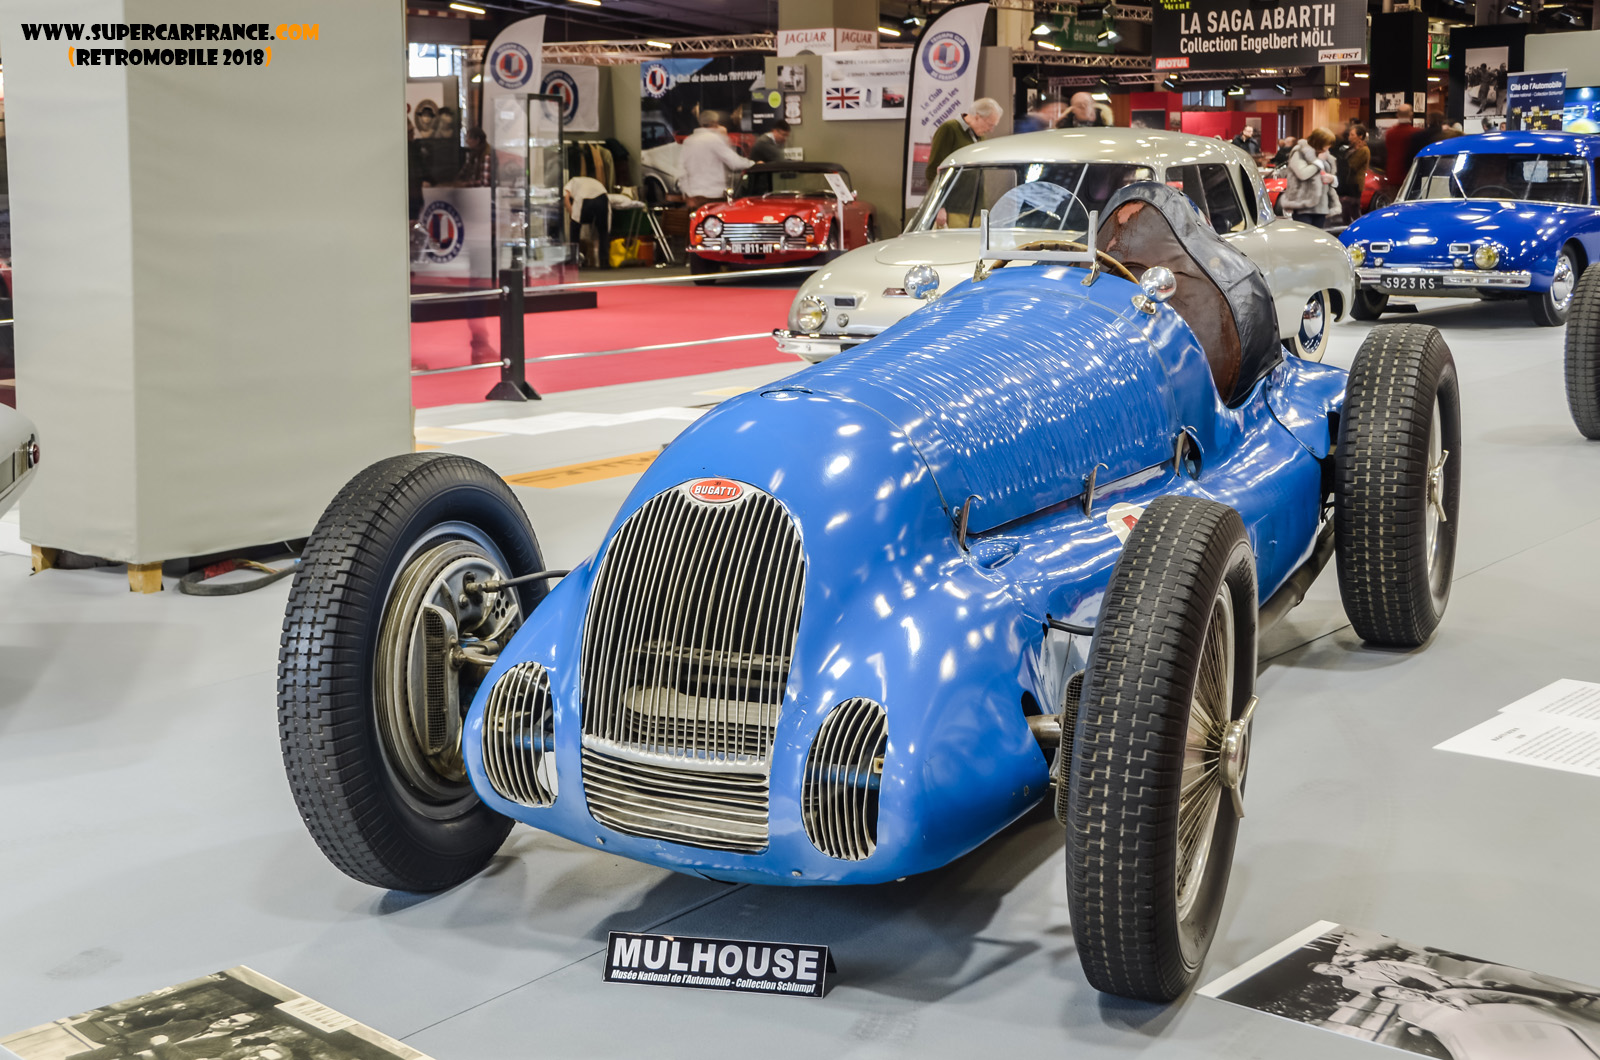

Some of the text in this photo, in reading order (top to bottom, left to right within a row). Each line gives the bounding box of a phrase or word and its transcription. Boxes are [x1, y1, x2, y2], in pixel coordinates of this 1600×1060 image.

[1180, 3, 1335, 35] LA SAGA ABARTH
[785, 31, 827, 45] JAGUAR
[841, 30, 872, 44] JAGUAR
[1180, 27, 1335, 54] Collection Engelbert MÖLL
[1157, 58, 1188, 68] MOTUL
[1510, 81, 1562, 92] Cité de l'Automobile
[928, 88, 943, 102] Club
[921, 116, 930, 127] de
[928, 96, 950, 118] Toutes
[933, 99, 962, 128] TRIUMPH
[1385, 276, 1435, 290] 5923 RS
[694, 485, 737, 496] BUGATTI
[612, 937, 819, 981] MULHOUSE
[611, 969, 637, 981] Musée
[637, 971, 671, 983] National
[671, 973, 681, 983] de
[682, 974, 731, 987] l'Automobile
[735, 978, 776, 990] Collection
[776, 982, 816, 993] Schlumpf
